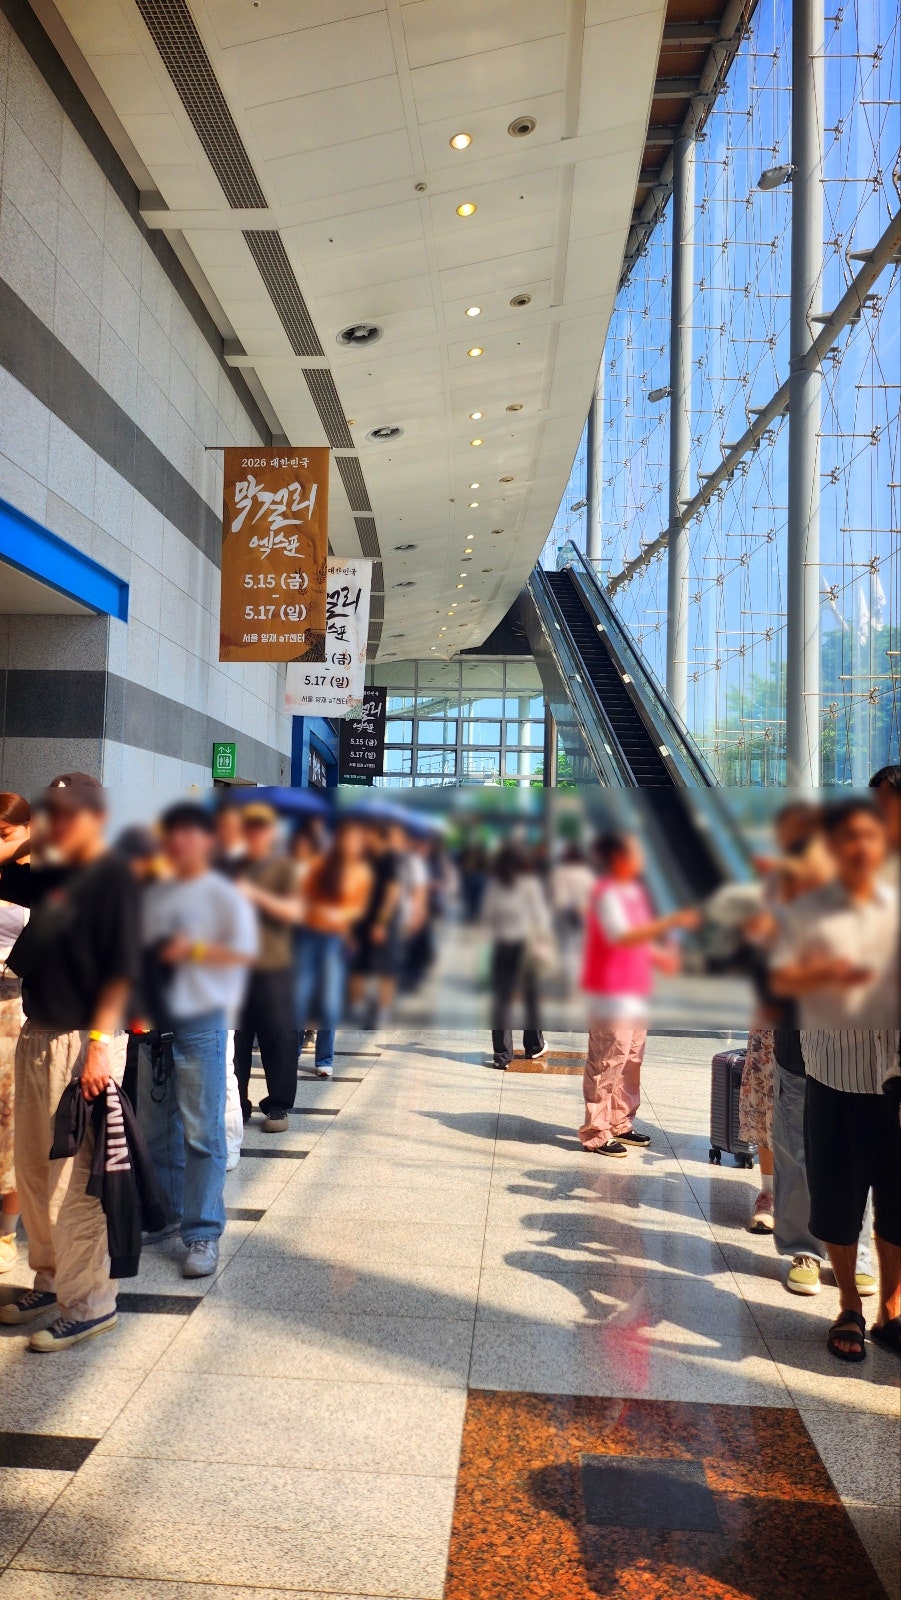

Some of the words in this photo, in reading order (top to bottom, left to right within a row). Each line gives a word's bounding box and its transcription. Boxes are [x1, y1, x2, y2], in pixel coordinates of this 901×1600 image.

[242, 458, 267, 467] 2026
[269, 457, 309, 468] 대한민국
[231, 475, 318, 533] 막걸리
[249, 531, 305, 560] 엑스포
[244, 573, 276, 588] 5.15
[281, 573, 308, 590] (금)
[244, 605, 275, 620] 5.17
[280, 605, 307, 622] (일)
[242, 633, 258, 643] 서울
[326, 621, 350, 642] 스포
[331, 652, 352, 666] (금)
[304, 675, 326, 686] 5.17
[330, 676, 349, 689] (일)
